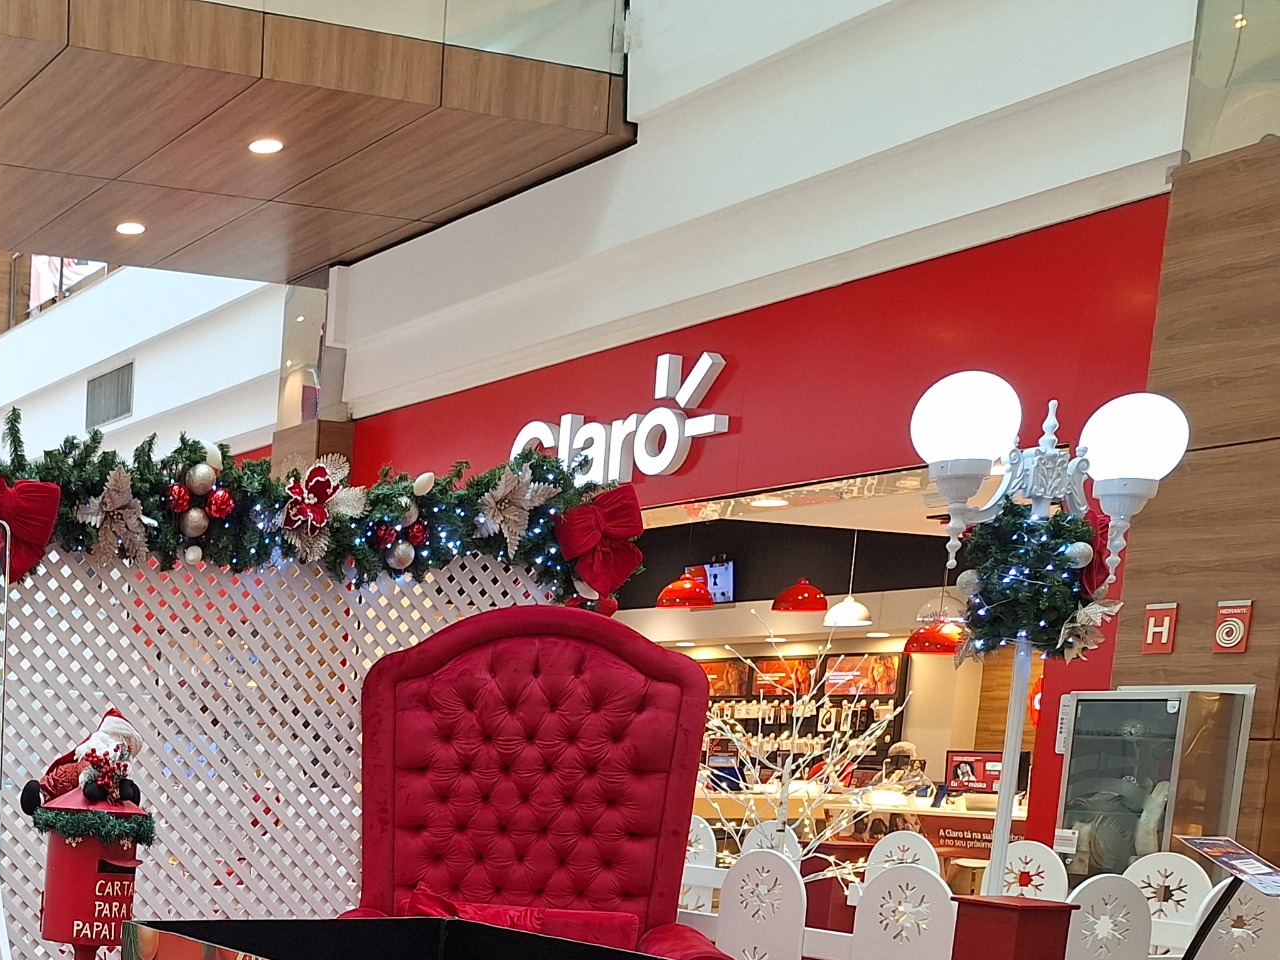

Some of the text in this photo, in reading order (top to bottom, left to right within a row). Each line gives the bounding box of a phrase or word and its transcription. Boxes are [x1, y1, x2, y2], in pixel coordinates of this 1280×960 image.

[1147, 616, 1171, 643] H
[945, 829, 963, 838] Claro
[964, 830, 971, 838] tá
[94, 901, 127, 918] PARA
[73, 920, 116, 940] PAPAI
